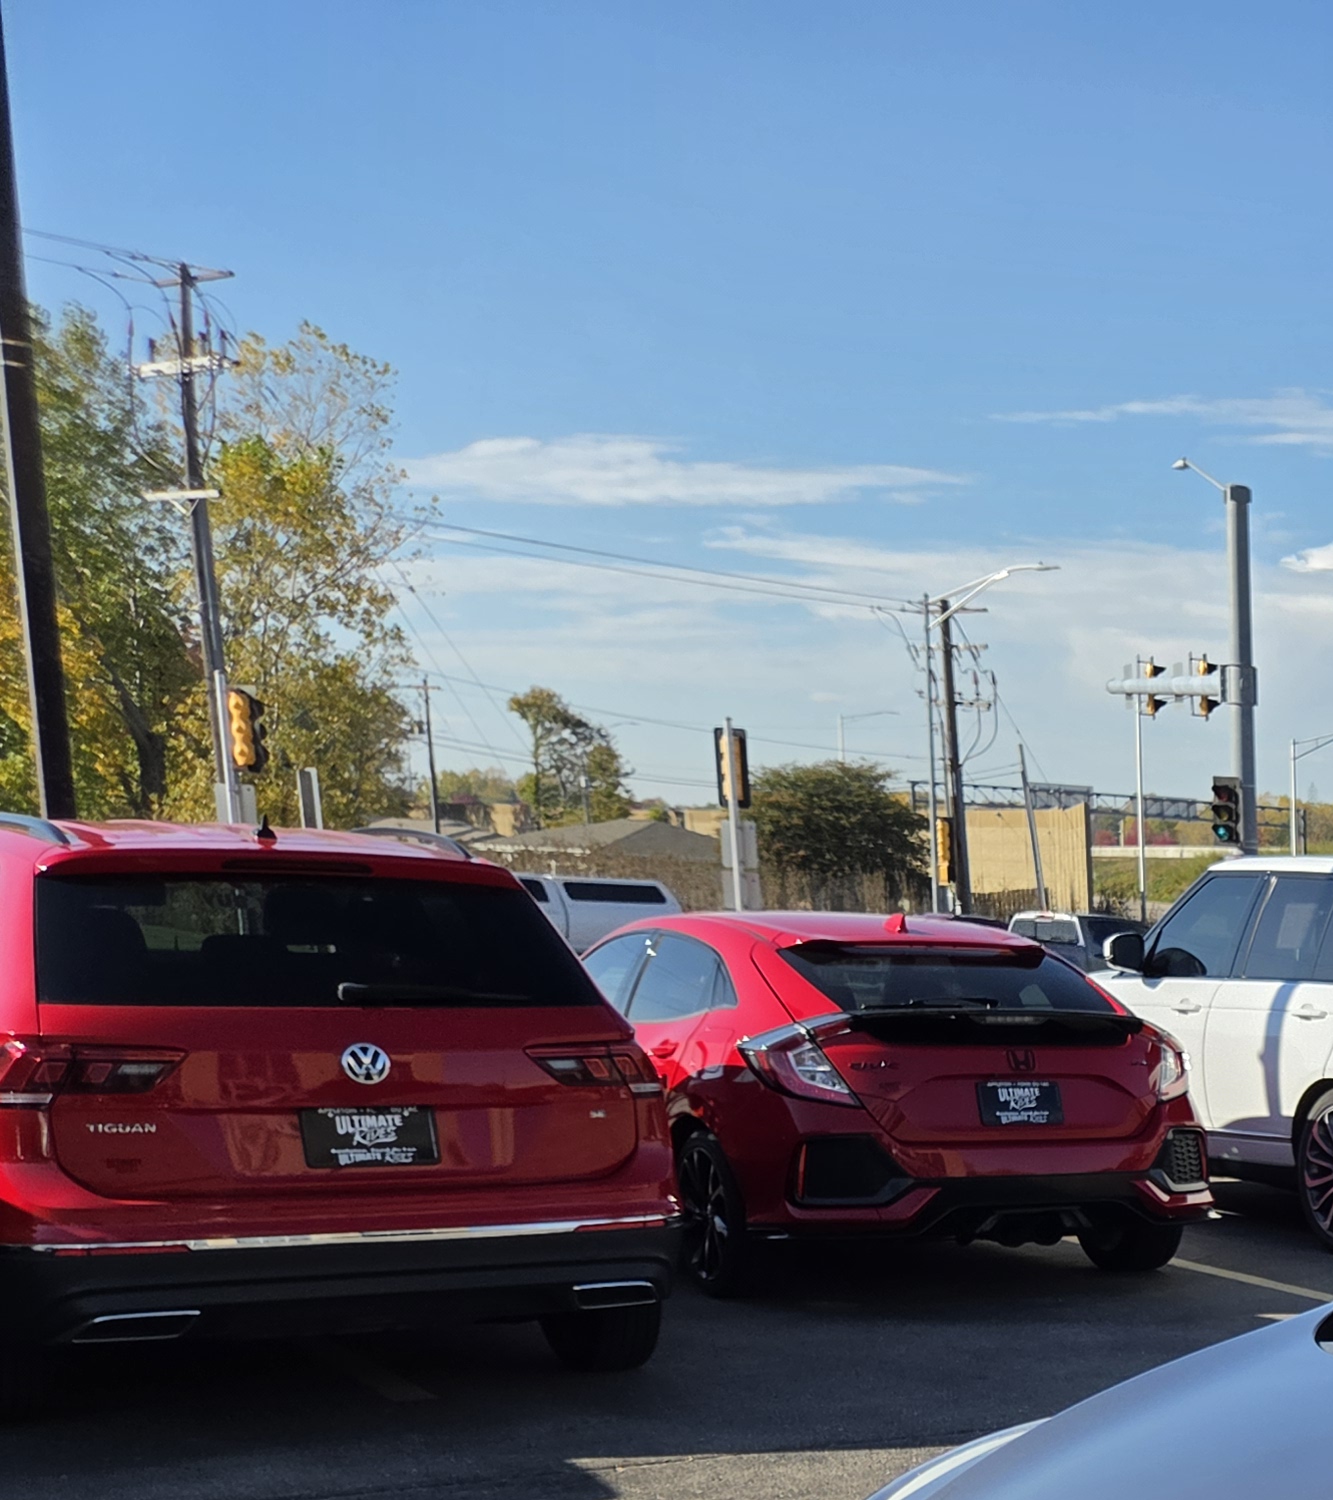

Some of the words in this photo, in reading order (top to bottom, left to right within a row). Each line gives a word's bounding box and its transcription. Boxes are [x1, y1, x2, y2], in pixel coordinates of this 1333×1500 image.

[998, 1087, 1041, 1102] ULTIMATE
[85, 1122, 157, 1133] TIGUAN
[335, 1114, 404, 1135] ULTIMATE
[352, 1126, 398, 1147] RIDES
